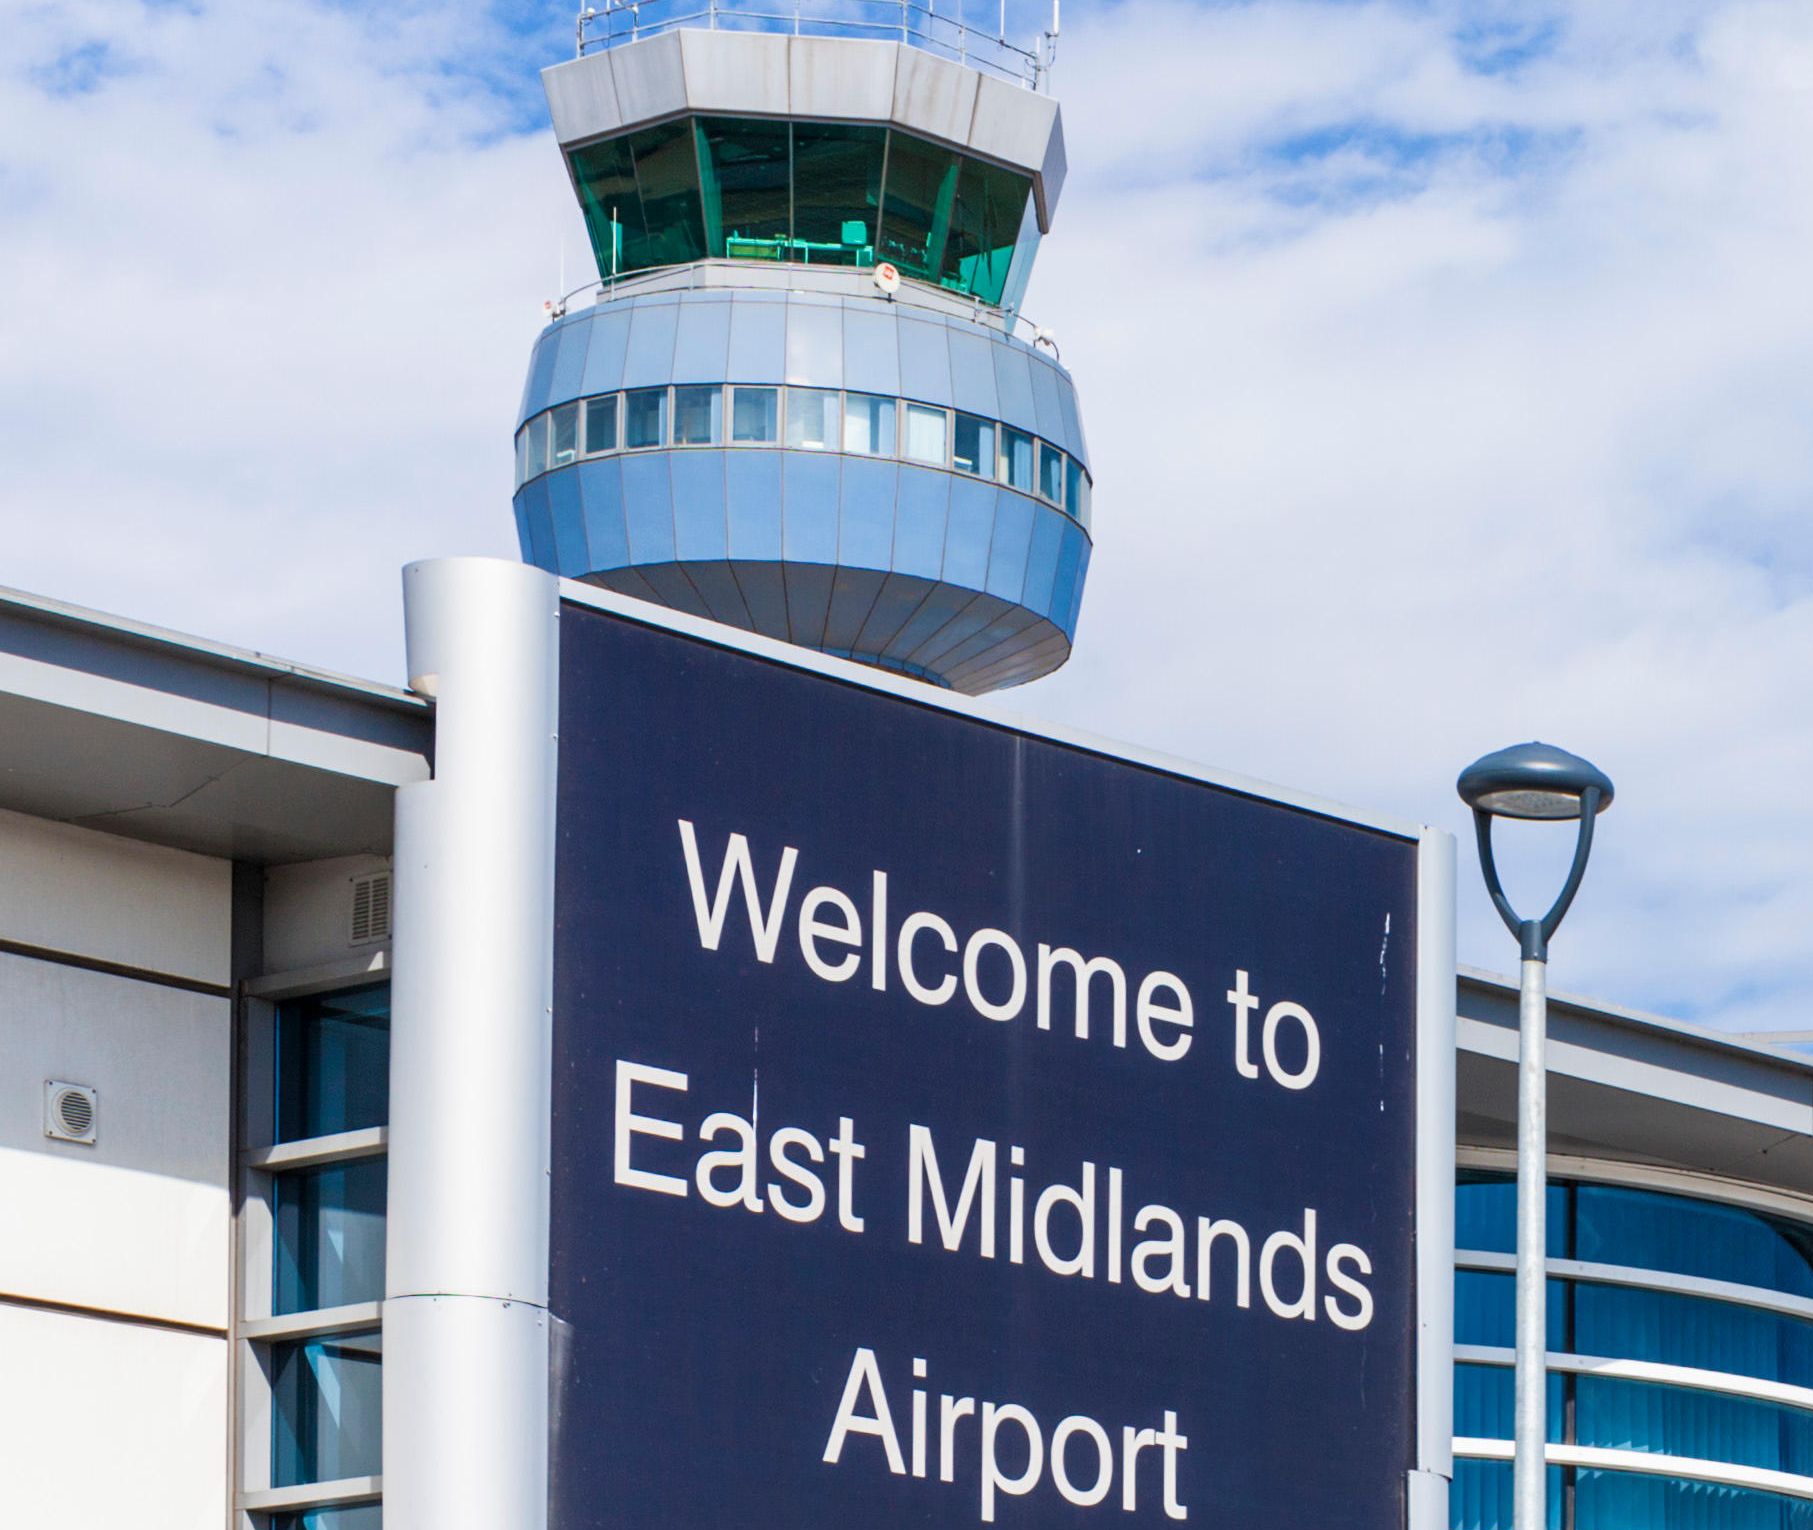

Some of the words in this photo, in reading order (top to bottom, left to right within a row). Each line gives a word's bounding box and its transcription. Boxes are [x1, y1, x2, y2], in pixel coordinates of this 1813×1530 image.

[678, 819, 1194, 1062] Welcome
[1227, 969, 1321, 1089] to
[614, 1059, 866, 1233] East
[908, 1123, 1374, 1331] Midlands
[822, 1347, 1188, 1523] Airport
